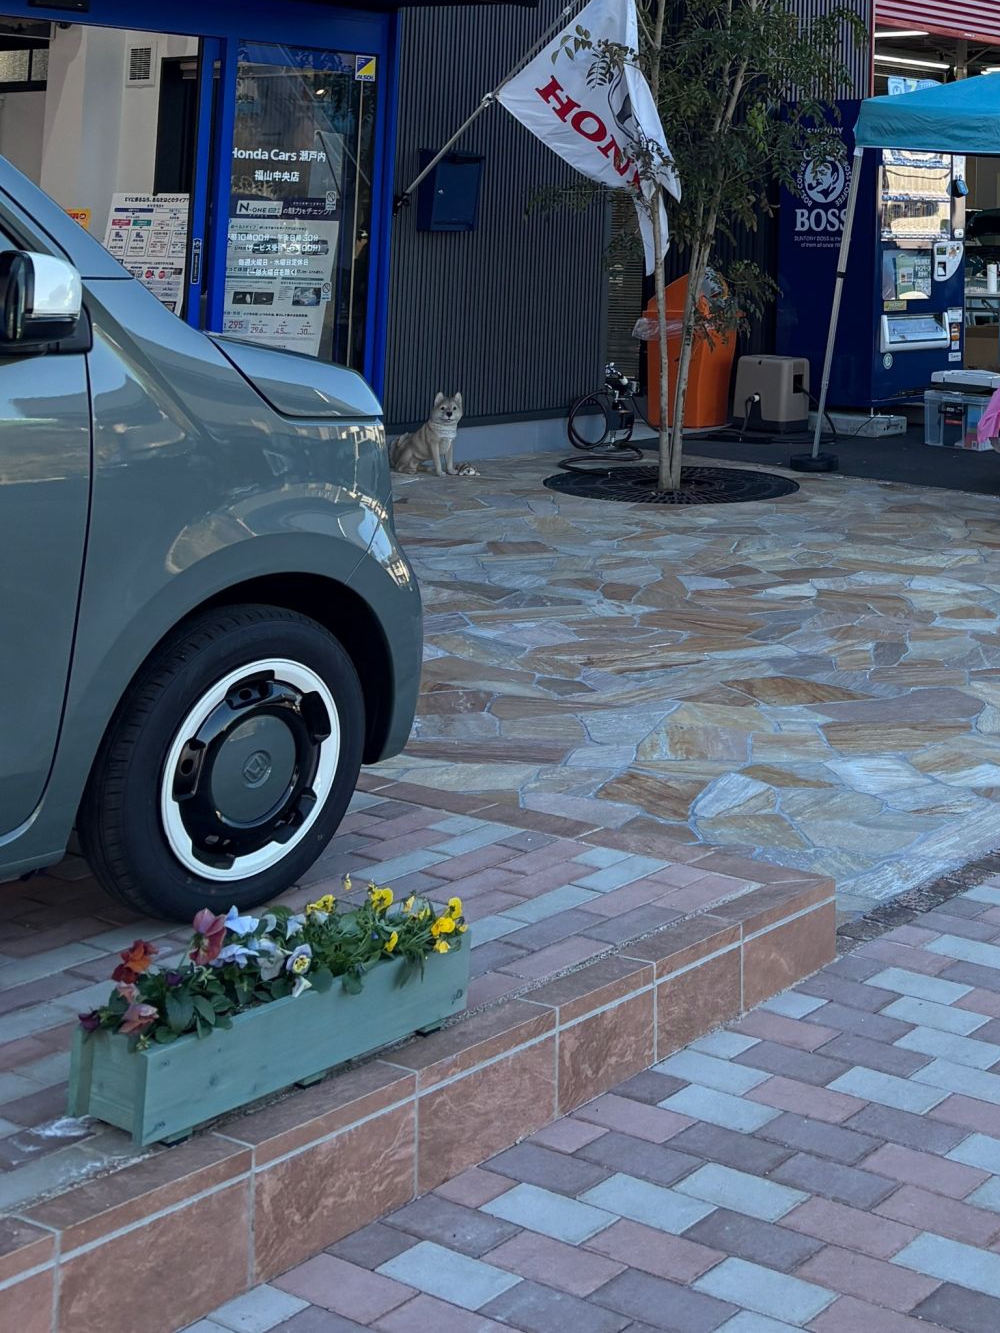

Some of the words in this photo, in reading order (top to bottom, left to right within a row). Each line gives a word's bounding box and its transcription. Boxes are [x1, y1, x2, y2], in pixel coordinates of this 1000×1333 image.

[271, 149, 297, 161] Cars
[299, 150, 326, 163] 瀬戸内
[254, 170, 300, 183] 福山中央店
[228, 320, 243, 329] 295
